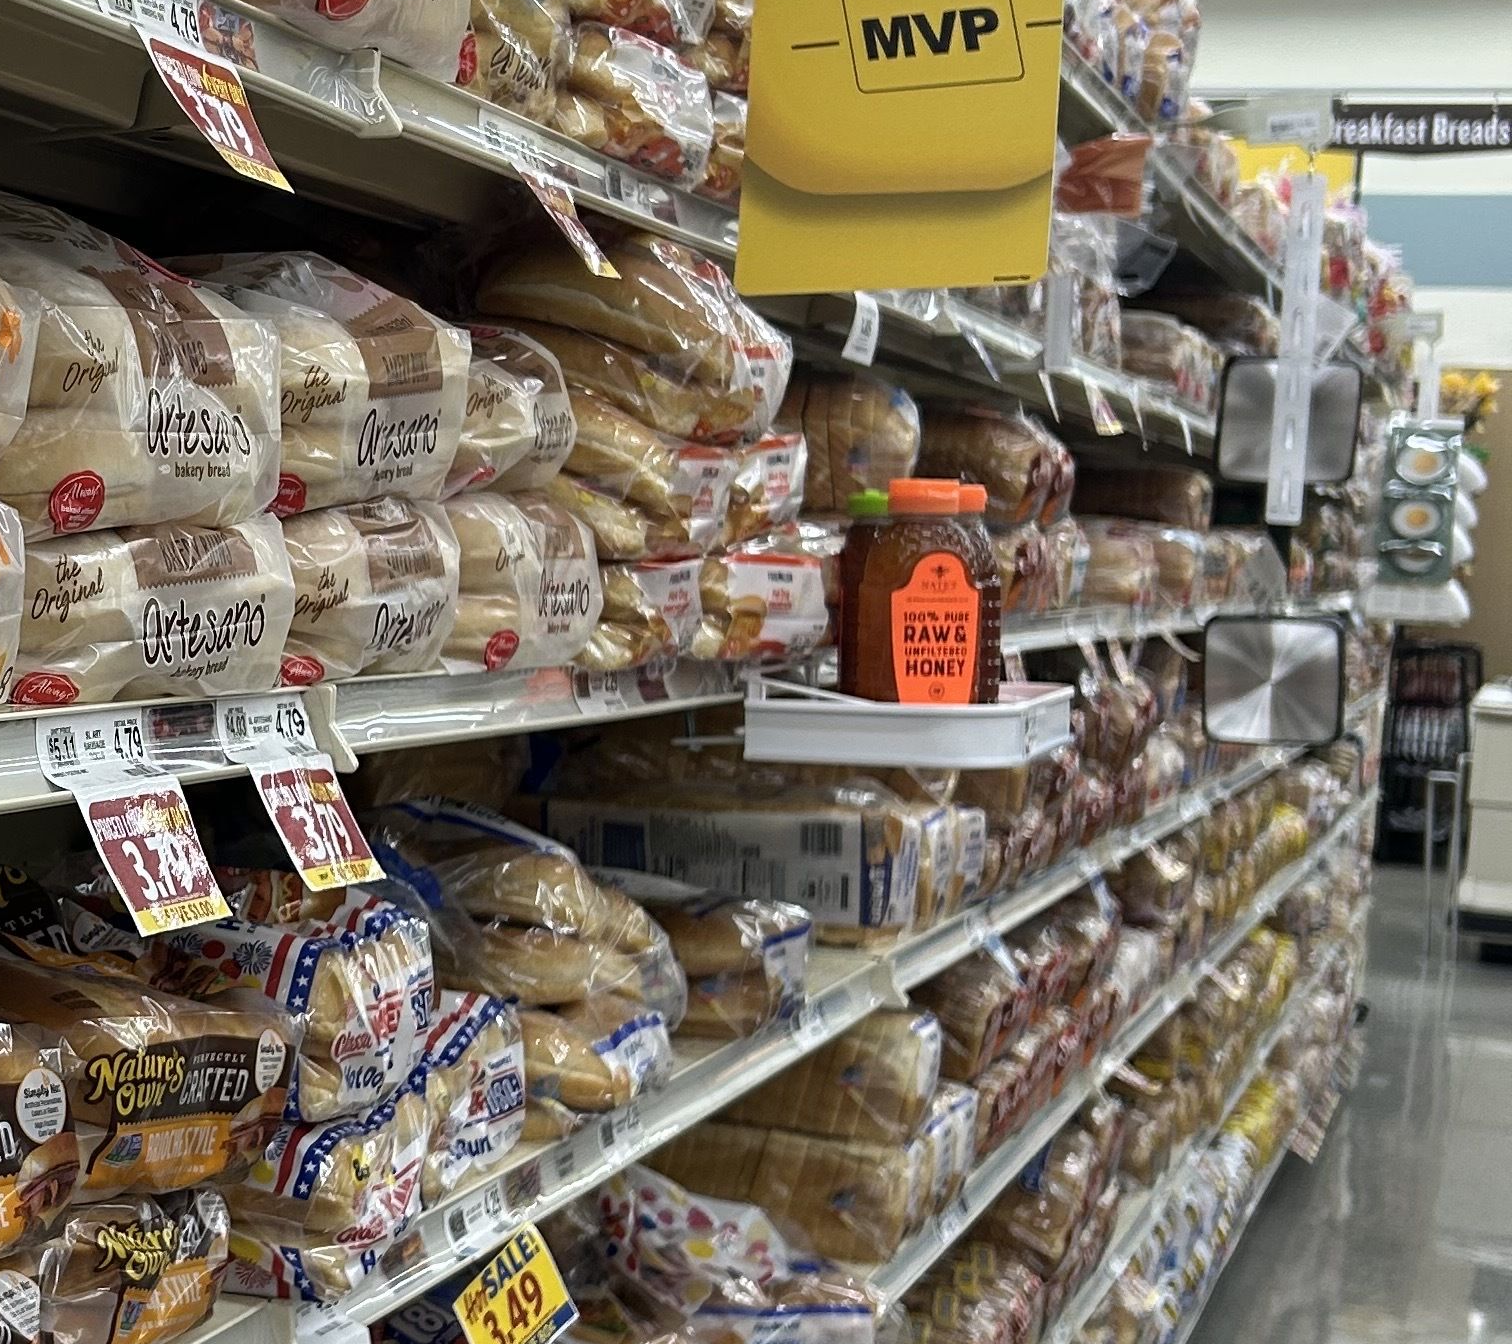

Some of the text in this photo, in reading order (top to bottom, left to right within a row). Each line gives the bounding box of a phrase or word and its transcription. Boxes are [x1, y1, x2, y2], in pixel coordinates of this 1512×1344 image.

[171, 3, 199, 44] 4.79
[861, 7, 999, 61] MVP
[1432, 113, 1512, 145] Breads
[304, 366, 331, 388] the
[56, 553, 81, 584] the
[31, 567, 105, 623] Original
[142, 594, 266, 665] Artesano
[904, 611, 969, 623] 100% PURE
[904, 626, 966, 643] RAW &
[904, 645, 967, 657] UNFILTERED
[906, 658, 965, 677] HONEY
[114, 726, 144, 759] 4.79
[89, 1051, 249, 1105] Nature's CRAFTED
[117, 1082, 164, 1116] Own
[482, 1230, 543, 1302] SALE!
